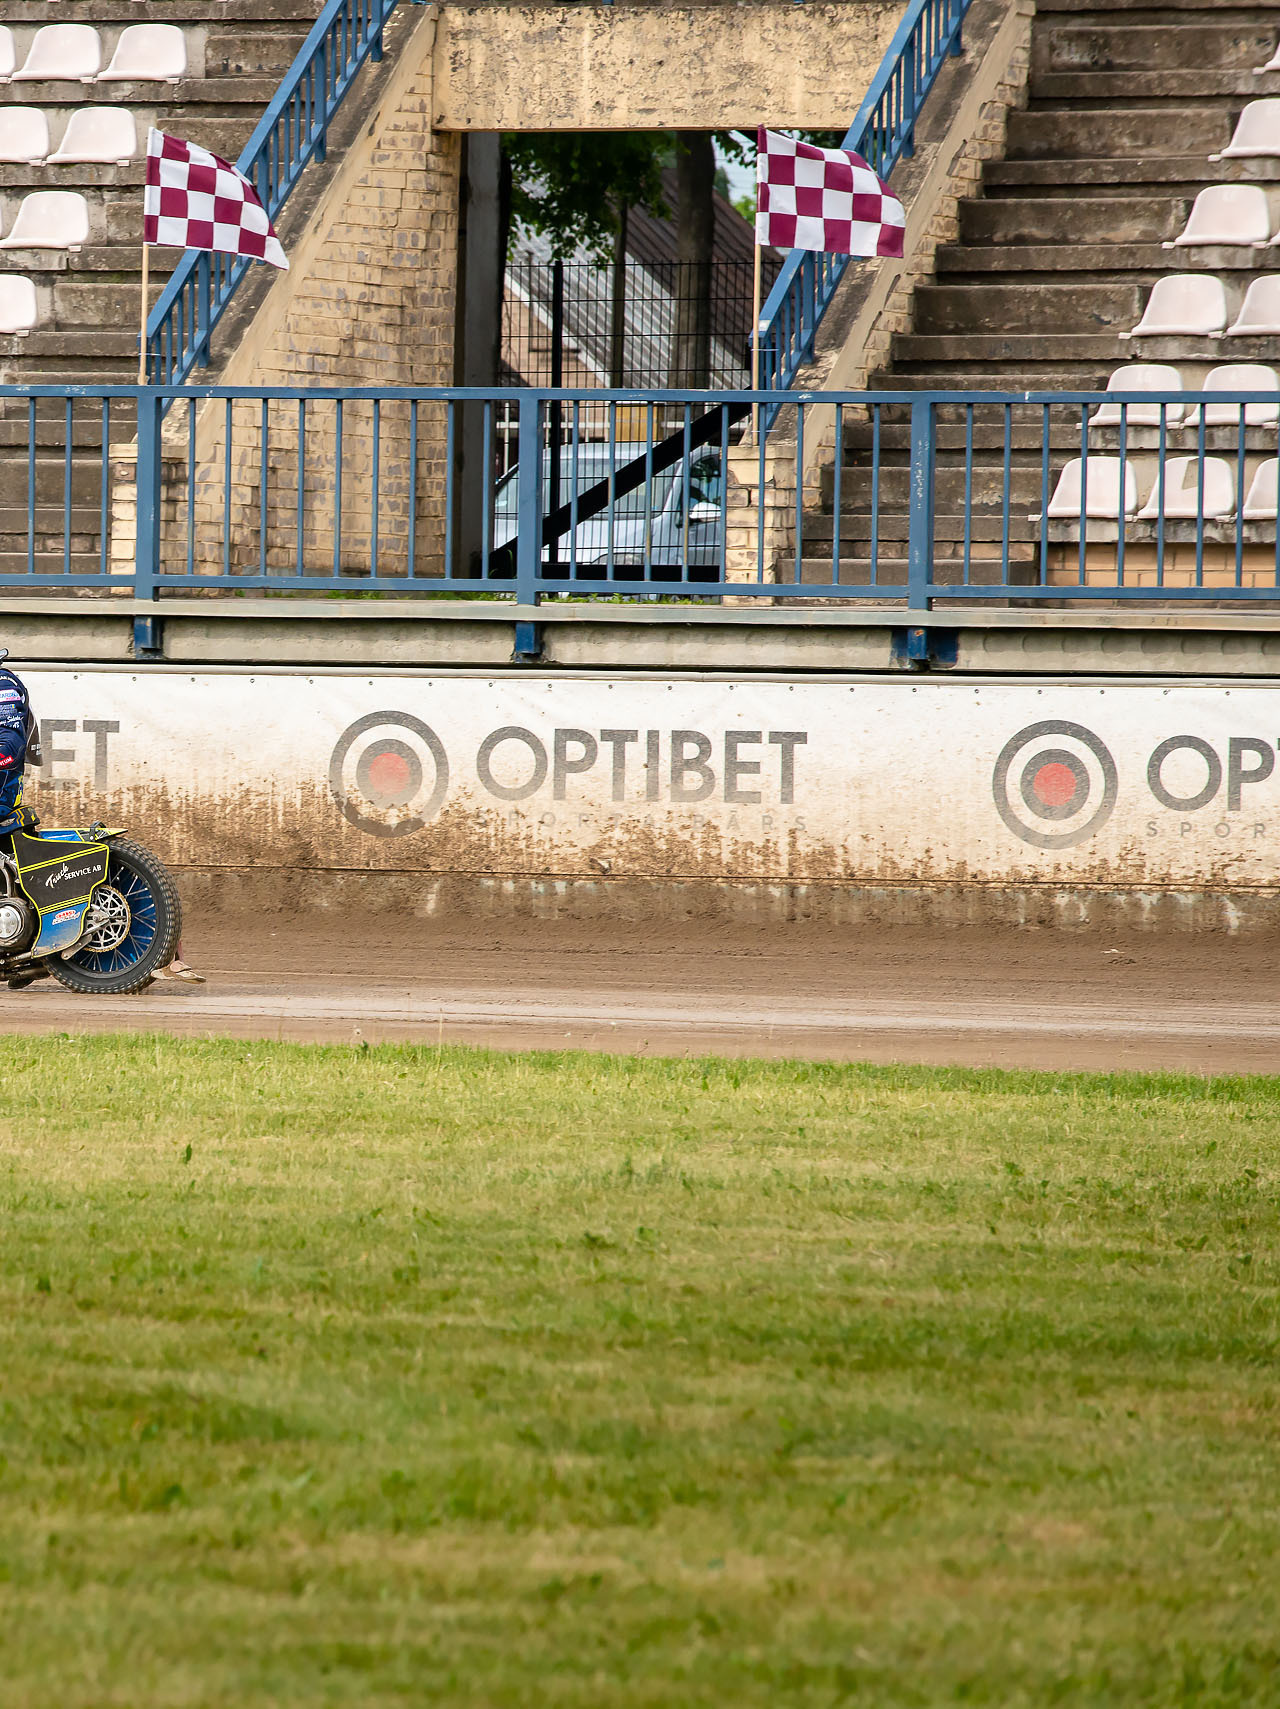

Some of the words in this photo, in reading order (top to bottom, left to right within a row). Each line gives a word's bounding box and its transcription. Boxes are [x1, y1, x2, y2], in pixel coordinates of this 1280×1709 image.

[476, 725, 808, 805] OPTIBET
[1147, 734, 1280, 811] OP
[64, 867, 91, 881] SERVICE
[92, 865, 102, 873] AB
